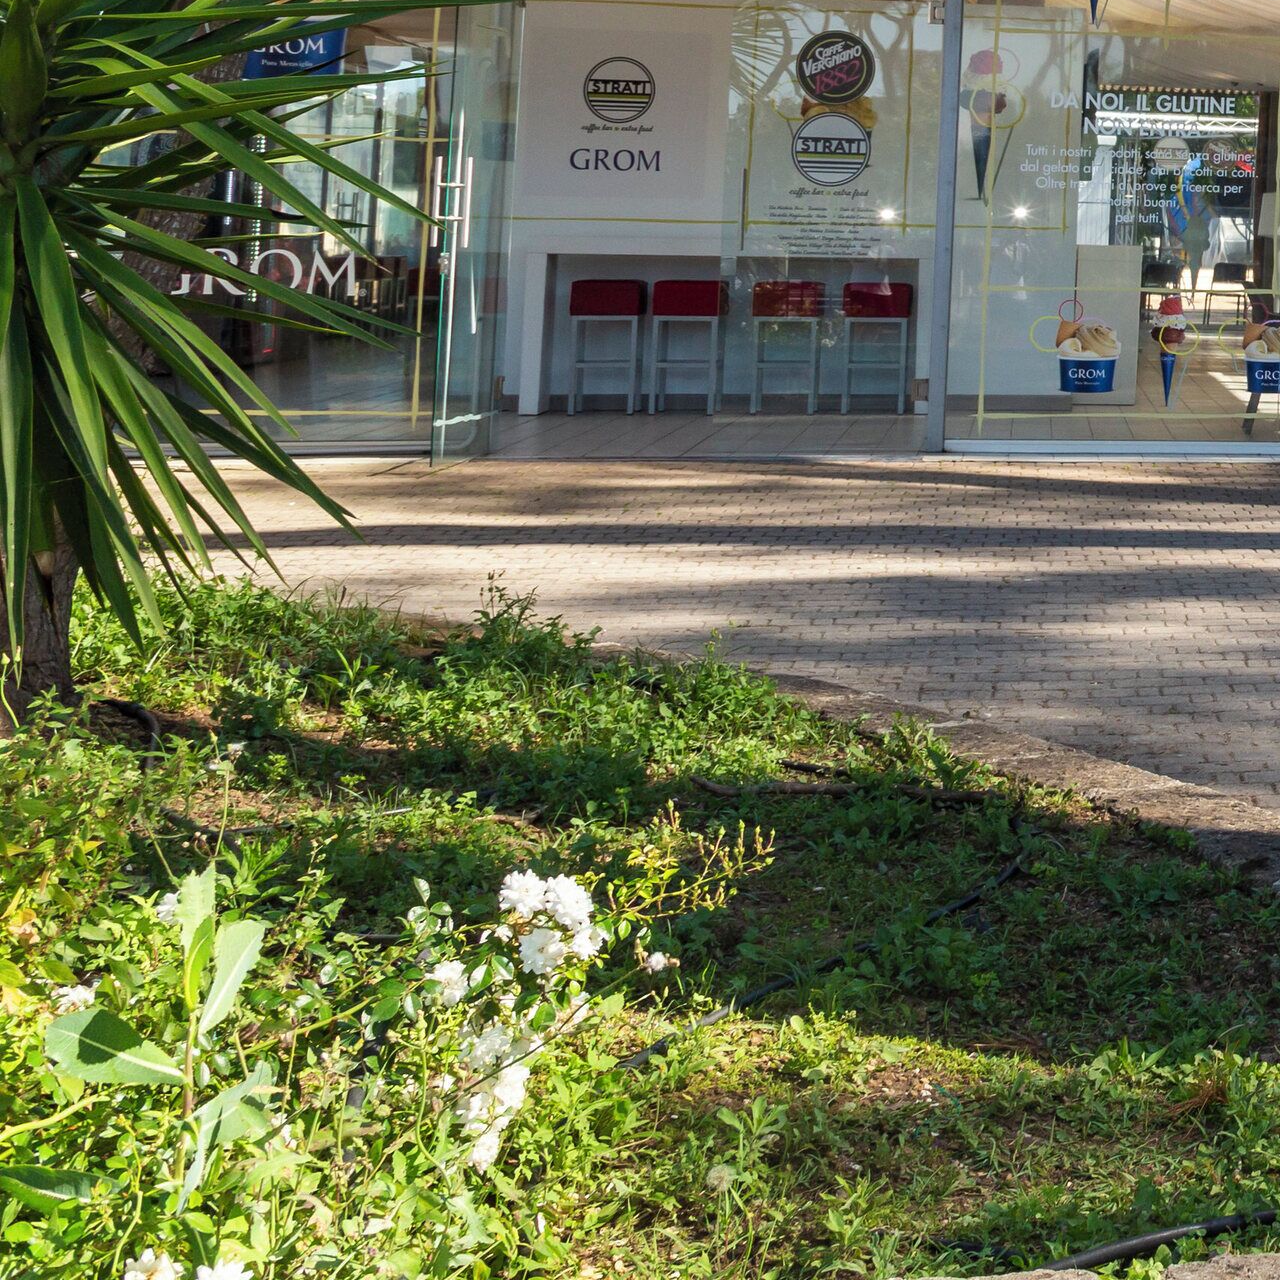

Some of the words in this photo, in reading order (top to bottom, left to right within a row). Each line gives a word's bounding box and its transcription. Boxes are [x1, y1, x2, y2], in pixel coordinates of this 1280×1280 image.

[803, 46, 861, 76] VERGNANO
[816, 59, 859, 93] 1882
[591, 80, 647, 94] STRATI
[1051, 93, 1078, 108] DA
[1085, 93, 1130, 113] NOI,
[1137, 95, 1150, 111] IL
[1156, 96, 1235, 114] GLUTINE
[1084, 117, 1132, 136] NON
[801, 139, 861, 154] STRATI
[570, 149, 661, 171] GROM
[1069, 368, 1105, 378] GROM
